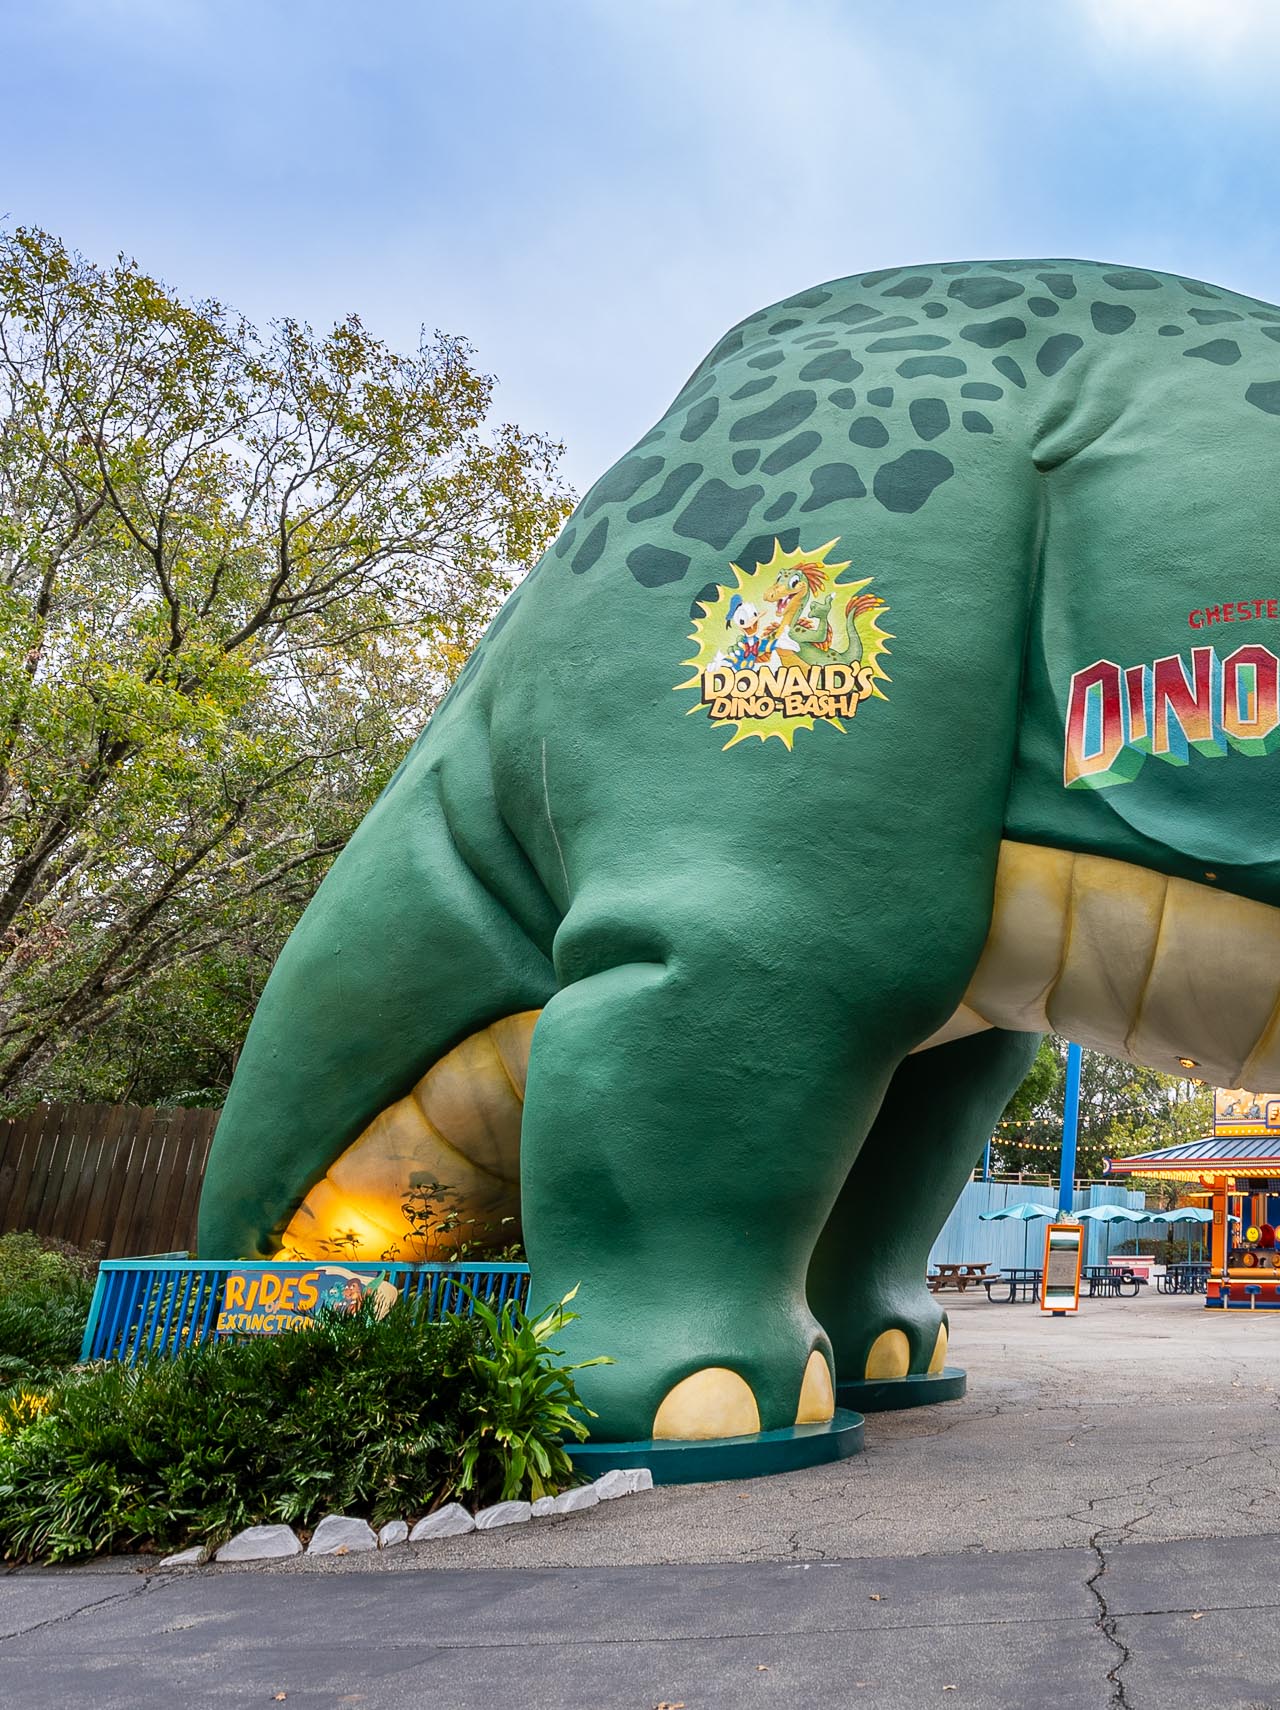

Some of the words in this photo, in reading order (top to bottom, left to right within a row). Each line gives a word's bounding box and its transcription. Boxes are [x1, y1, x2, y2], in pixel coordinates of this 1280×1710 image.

[702, 661, 873, 703] DONALD'S
[708, 692, 860, 719] DINO-BASH!
[224, 1273, 321, 1312] RIDES
[216, 1312, 316, 1333] EXTINCTION
